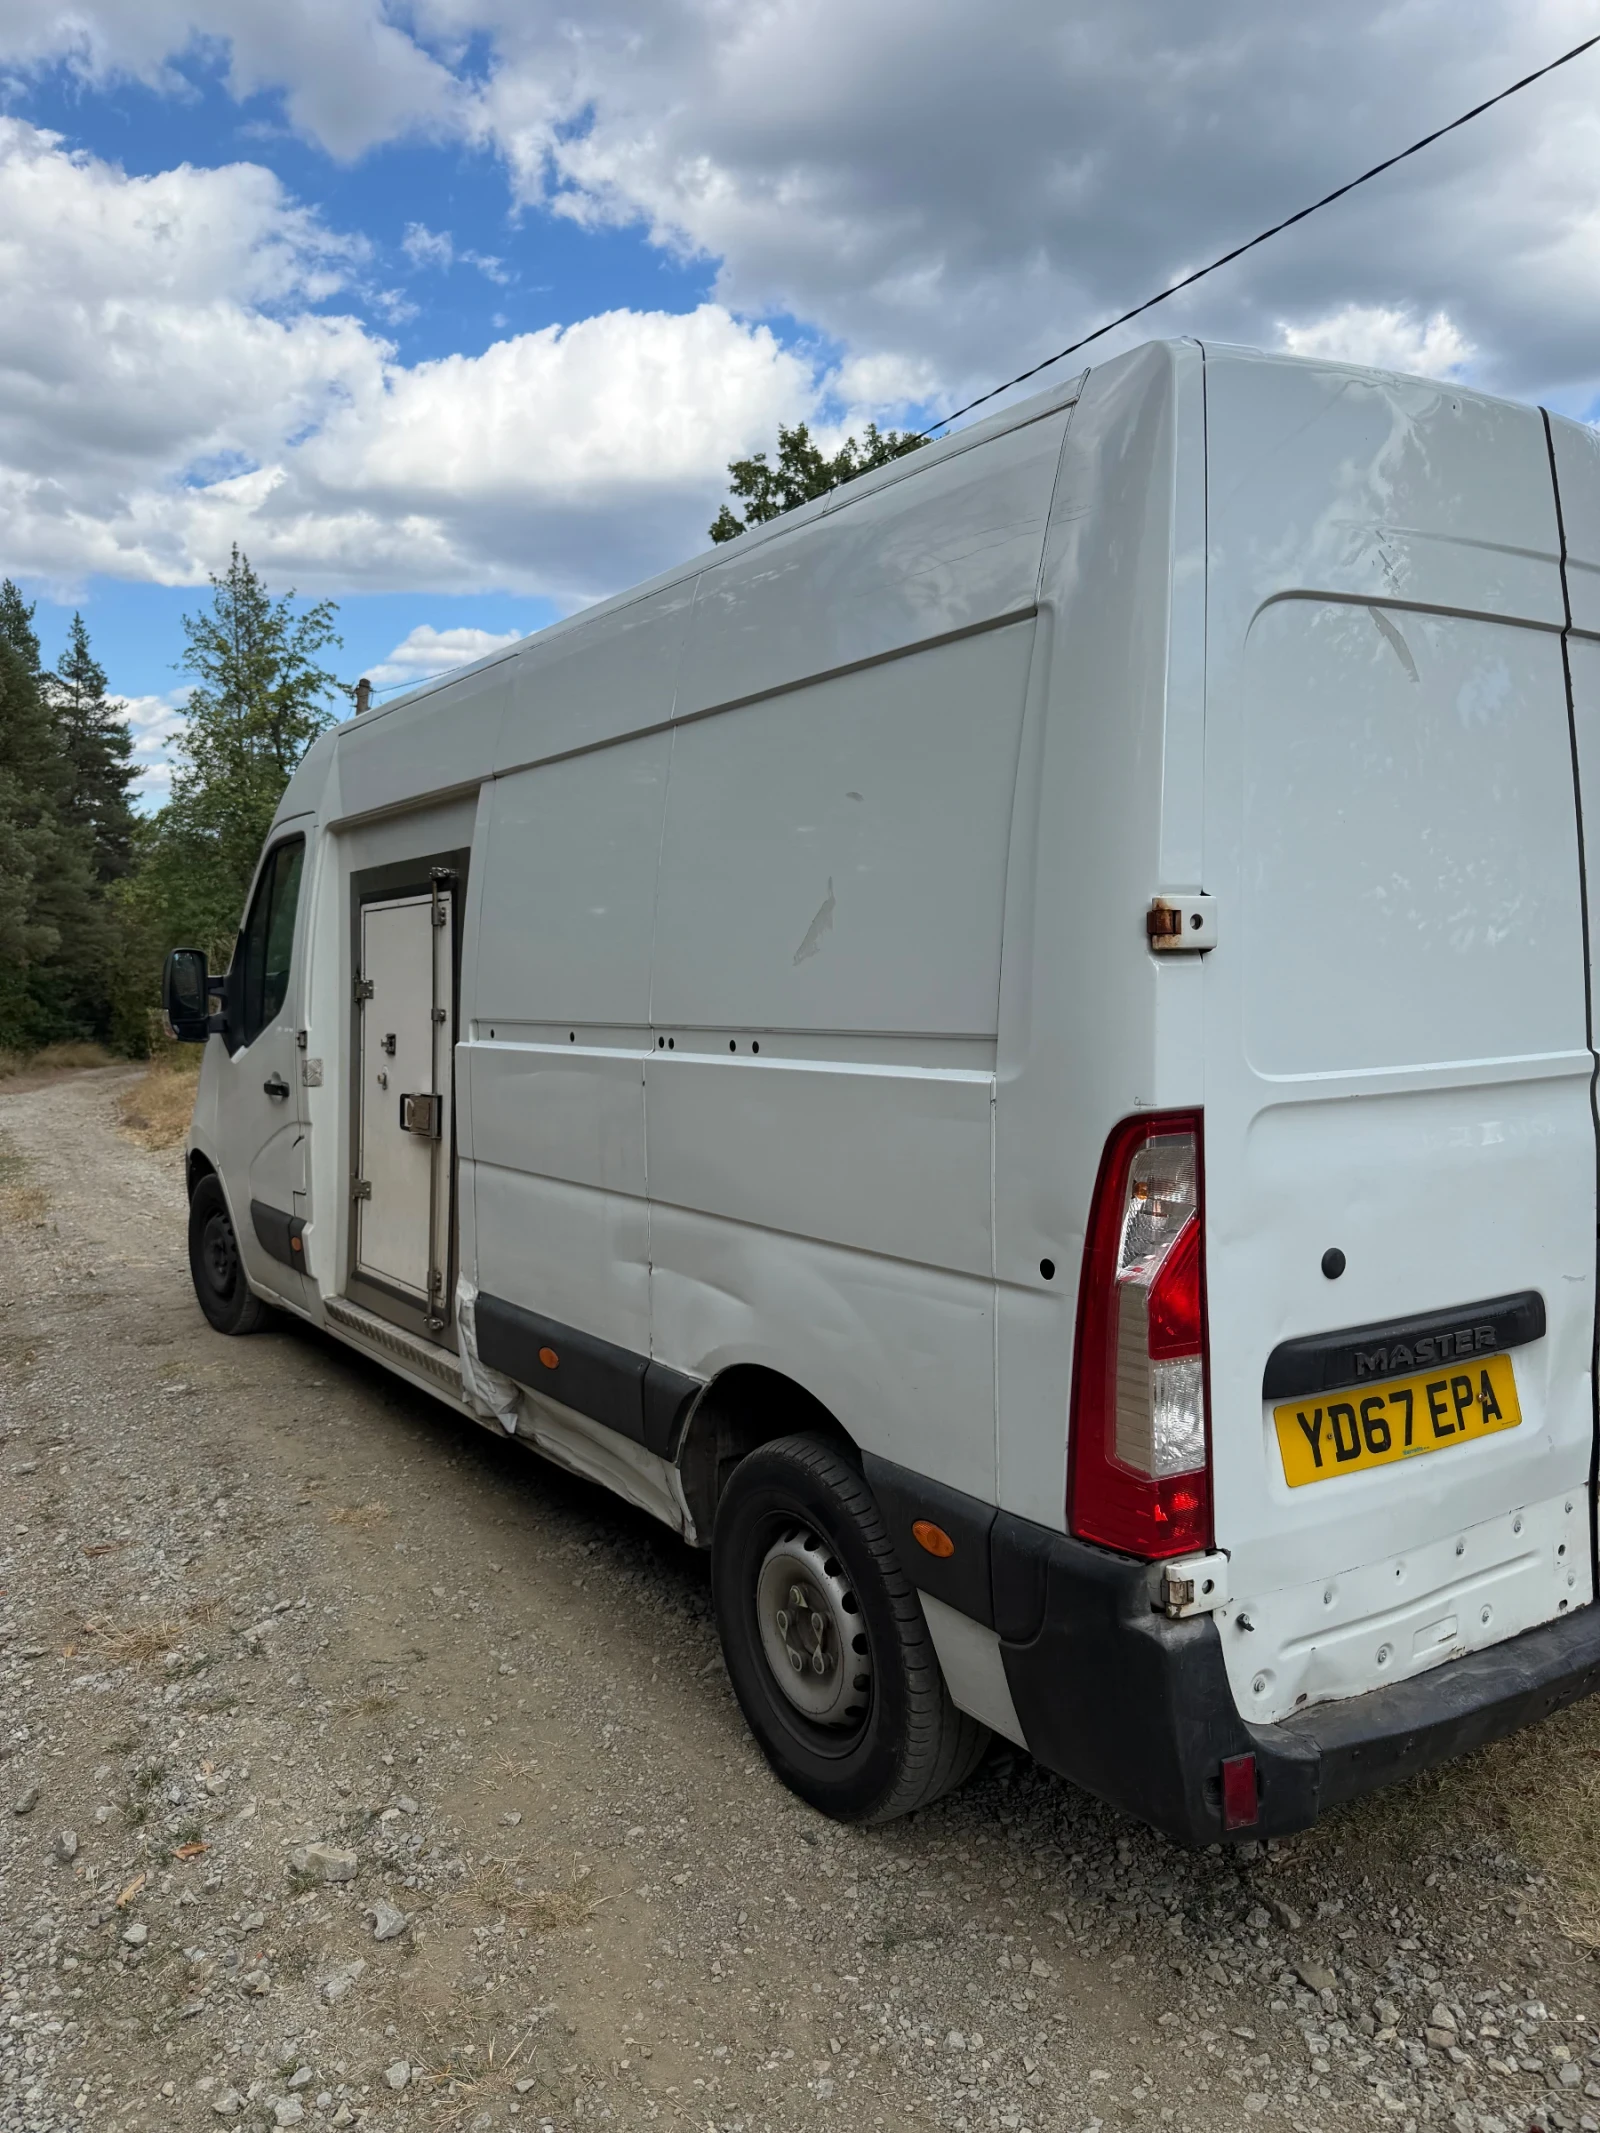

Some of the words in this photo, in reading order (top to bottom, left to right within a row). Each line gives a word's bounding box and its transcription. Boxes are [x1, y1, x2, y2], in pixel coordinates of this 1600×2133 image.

[1354, 1325, 1498, 1376] MASTER
[1296, 1388, 1414, 1468] YD67
[1426, 1369, 1503, 1438] EPA
